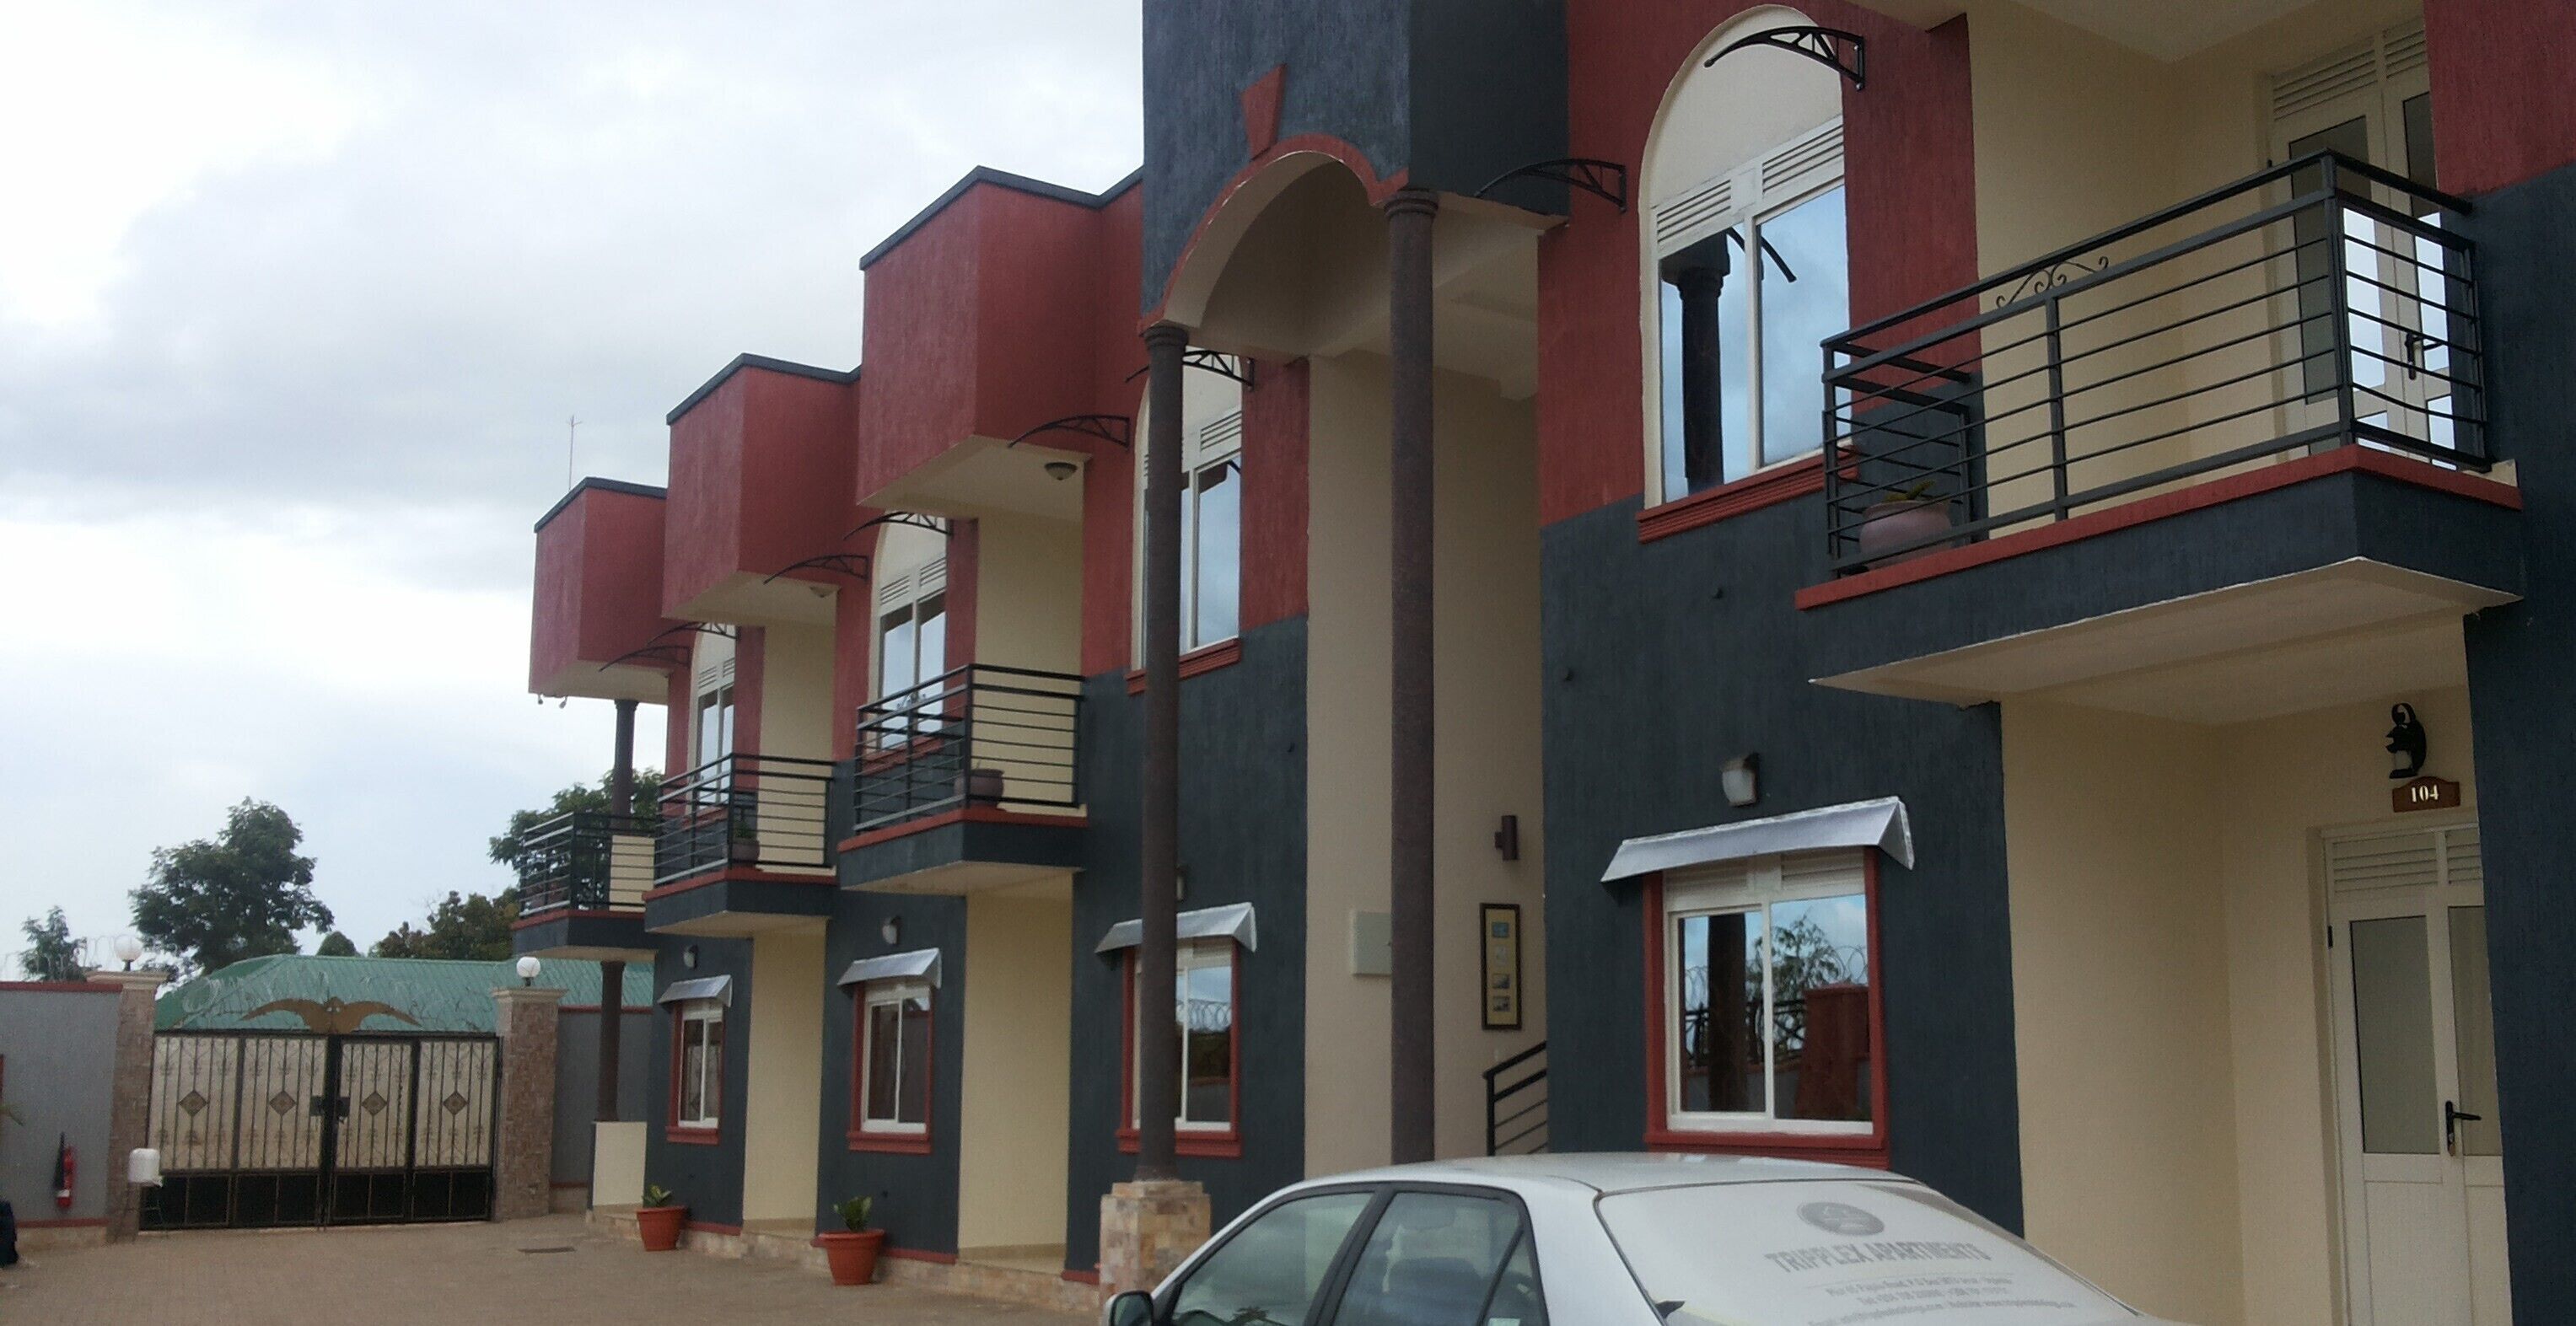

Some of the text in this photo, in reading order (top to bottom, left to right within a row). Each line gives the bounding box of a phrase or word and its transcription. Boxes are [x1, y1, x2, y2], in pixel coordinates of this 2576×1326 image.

[2411, 785, 2439, 803] 104
[1764, 1241, 1992, 1273] TRIPPLEX APARTMENTS
